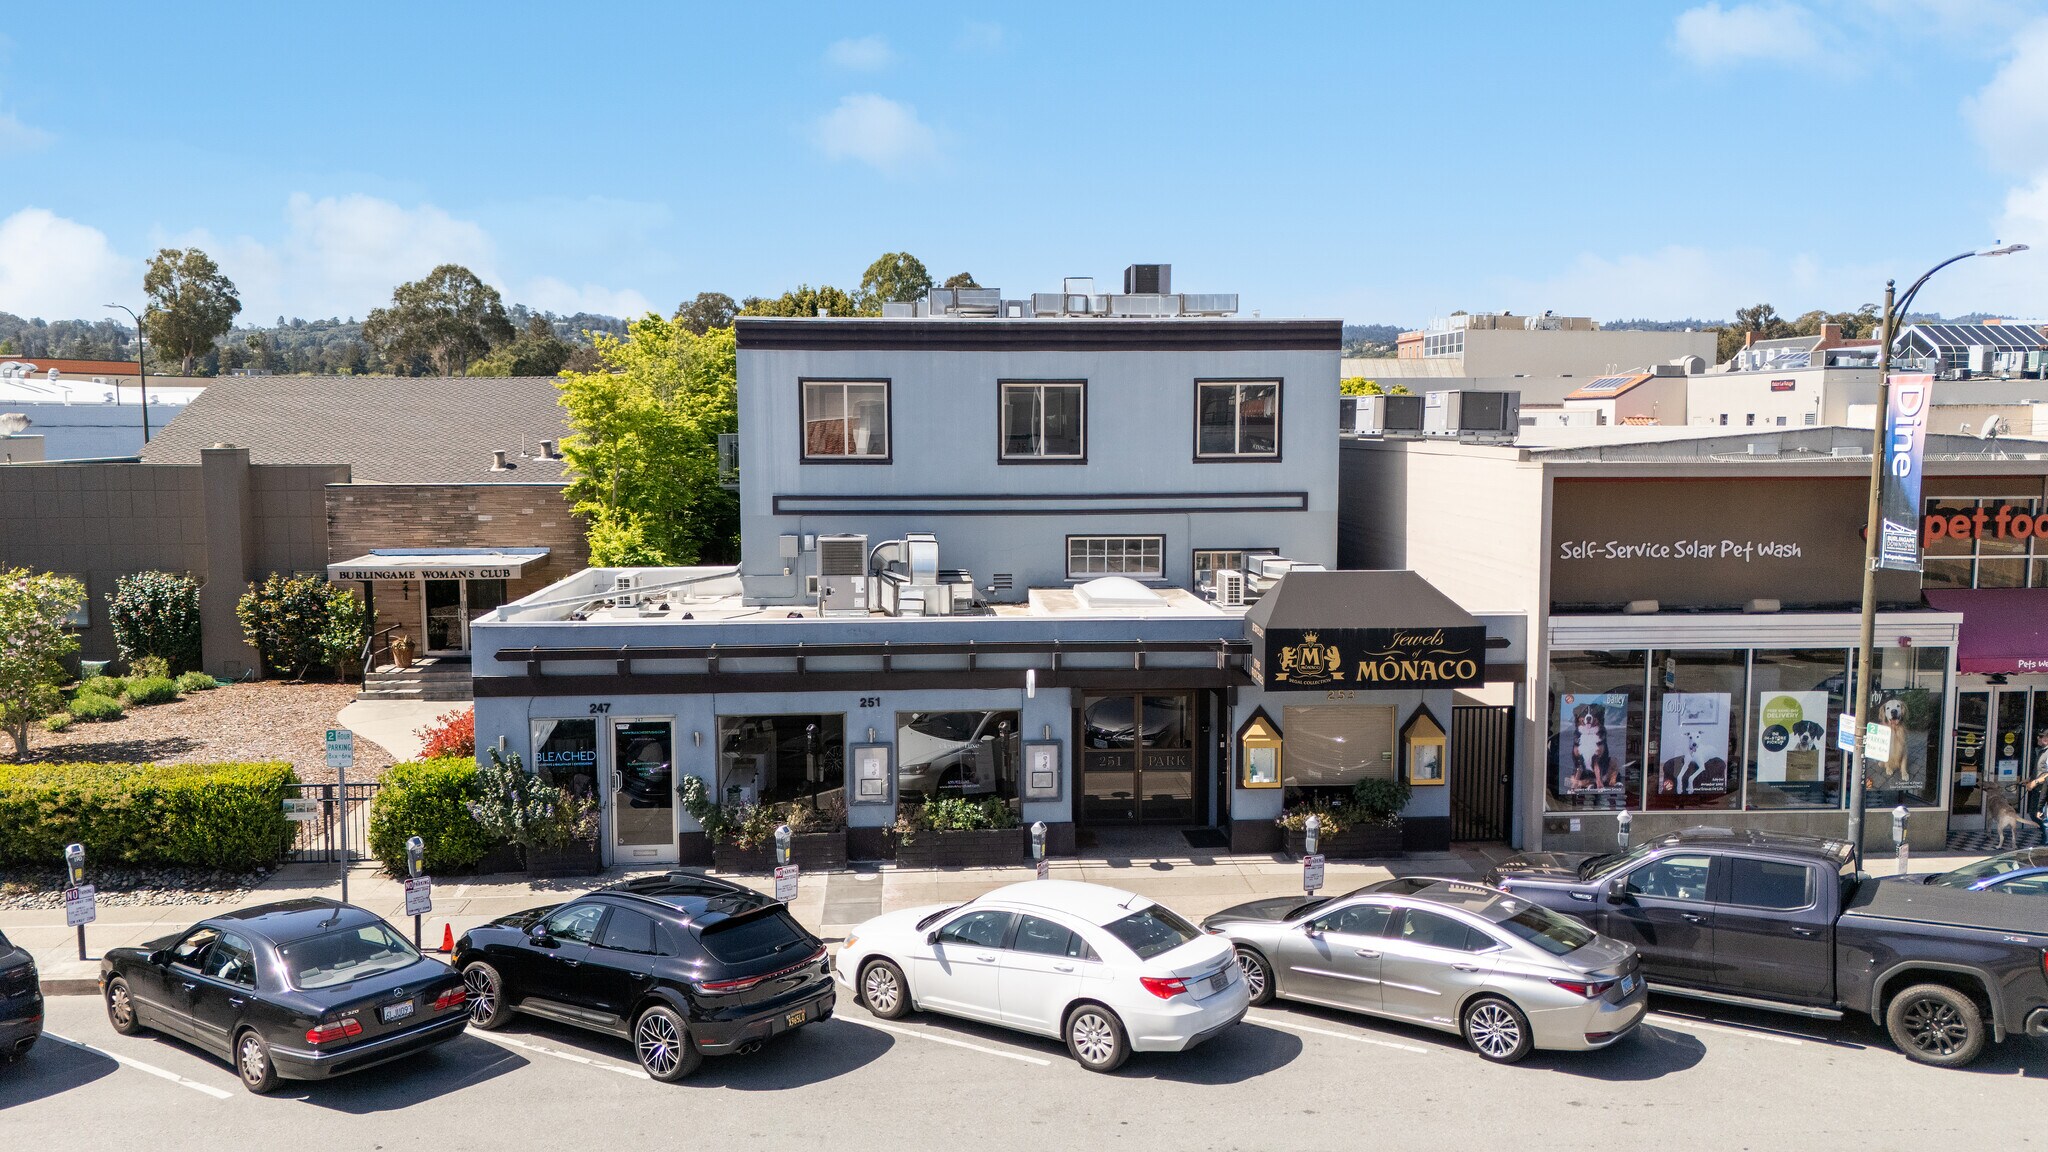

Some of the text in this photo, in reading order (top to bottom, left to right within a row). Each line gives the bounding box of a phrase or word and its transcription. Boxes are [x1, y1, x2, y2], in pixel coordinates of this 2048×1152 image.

[1892, 384, 1925, 477] Dine
[1923, 507, 1989, 549] pet
[1560, 540, 1802, 562] Self-Service Solar Pet Wash
[339, 570, 416, 579] BURLINGAME
[480, 569, 511, 578] CLUB
[1383, 628, 1445, 649] Jewels
[1300, 647, 1321, 666] M
[1411, 649, 1420, 659] of
[1356, 655, 1477, 682] MÔNACO
[2018, 660, 2037, 670] Pets
[1327, 690, 1355, 700] 253
[1606, 693, 1626, 707] Bailey
[589, 703, 611, 714] 247
[859, 697, 881, 708] 251
[1666, 699, 1686, 716] Colby
[328, 731, 334, 740] 2
[328, 743, 352, 751] PARKING
[535, 750, 597, 762] BLEACHED
[1099, 755, 1186, 767] 251 PARK
[67, 889, 79, 900] NO
